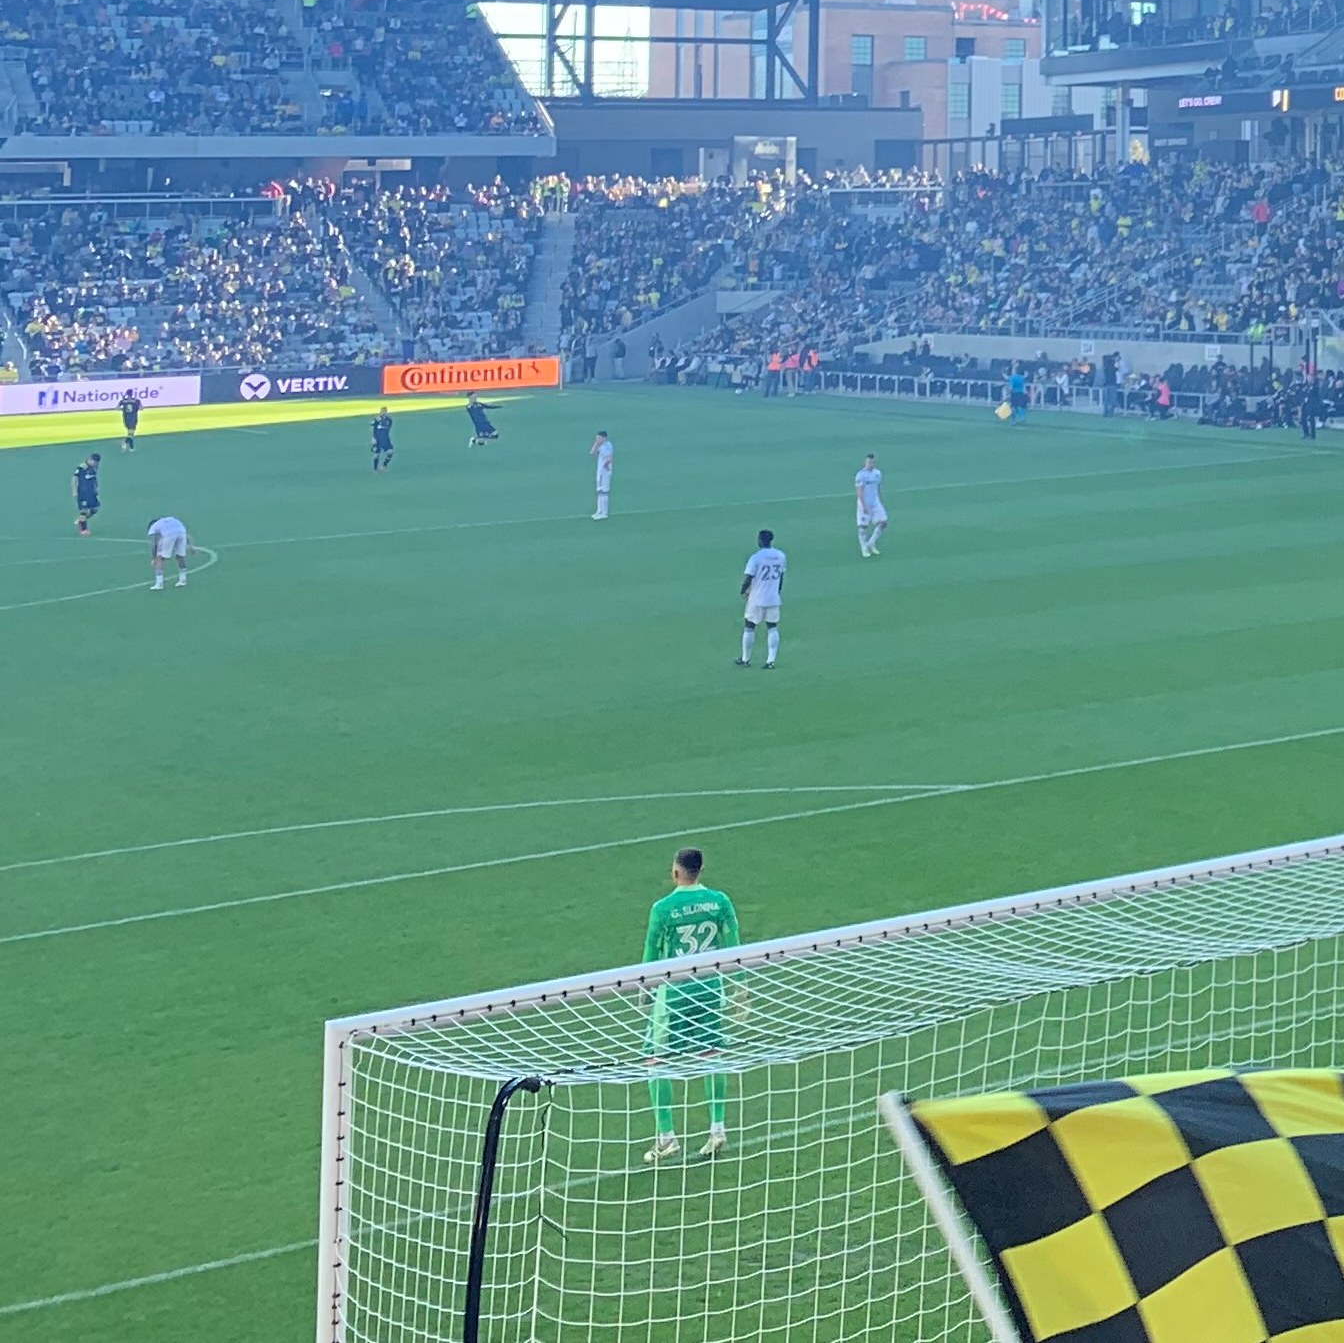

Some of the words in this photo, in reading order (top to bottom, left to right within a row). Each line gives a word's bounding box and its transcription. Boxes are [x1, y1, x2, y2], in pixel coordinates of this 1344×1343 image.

[401, 363, 523, 391] Continental
[761, 564, 781, 581] 23
[675, 920, 718, 957] 32
